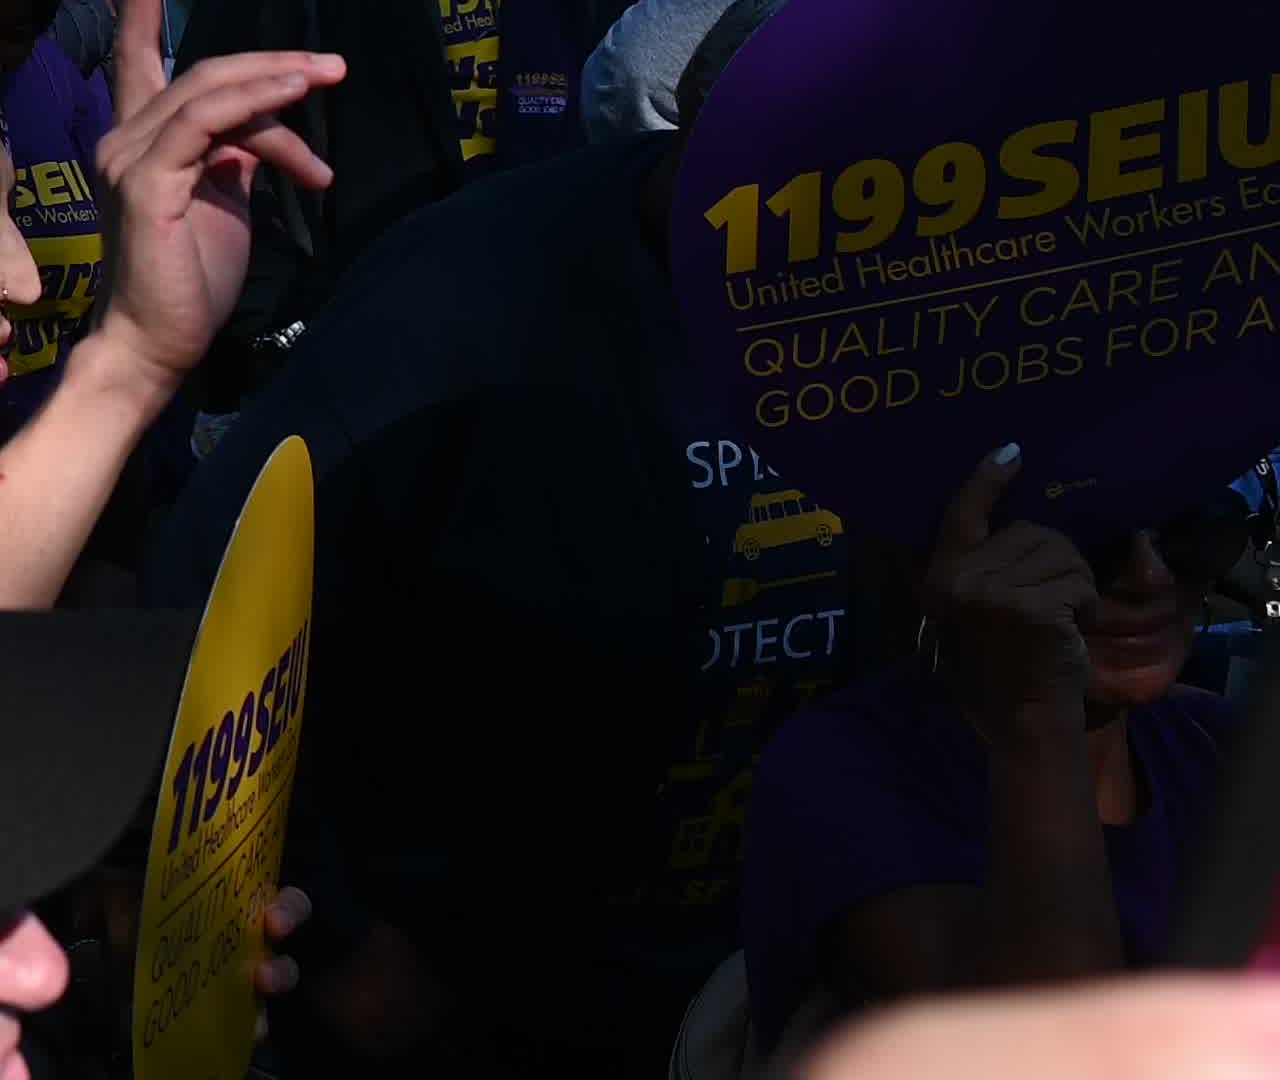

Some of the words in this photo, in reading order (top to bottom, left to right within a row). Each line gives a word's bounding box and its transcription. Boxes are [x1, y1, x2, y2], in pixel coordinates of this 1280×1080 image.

[704, 73, 1280, 275] 1199SEIU
[725, 263, 846, 312] United
[856, 224, 1057, 291] Healthcare
[1063, 188, 1226, 248] Workers
[744, 295, 1000, 379] QUALITY
[1019, 260, 1183, 328] CARE
[1202, 246, 1280, 291] AN
[753, 367, 921, 430] GOOD
[935, 335, 1085, 400] JOBS
[1105, 308, 1219, 368] FOR
